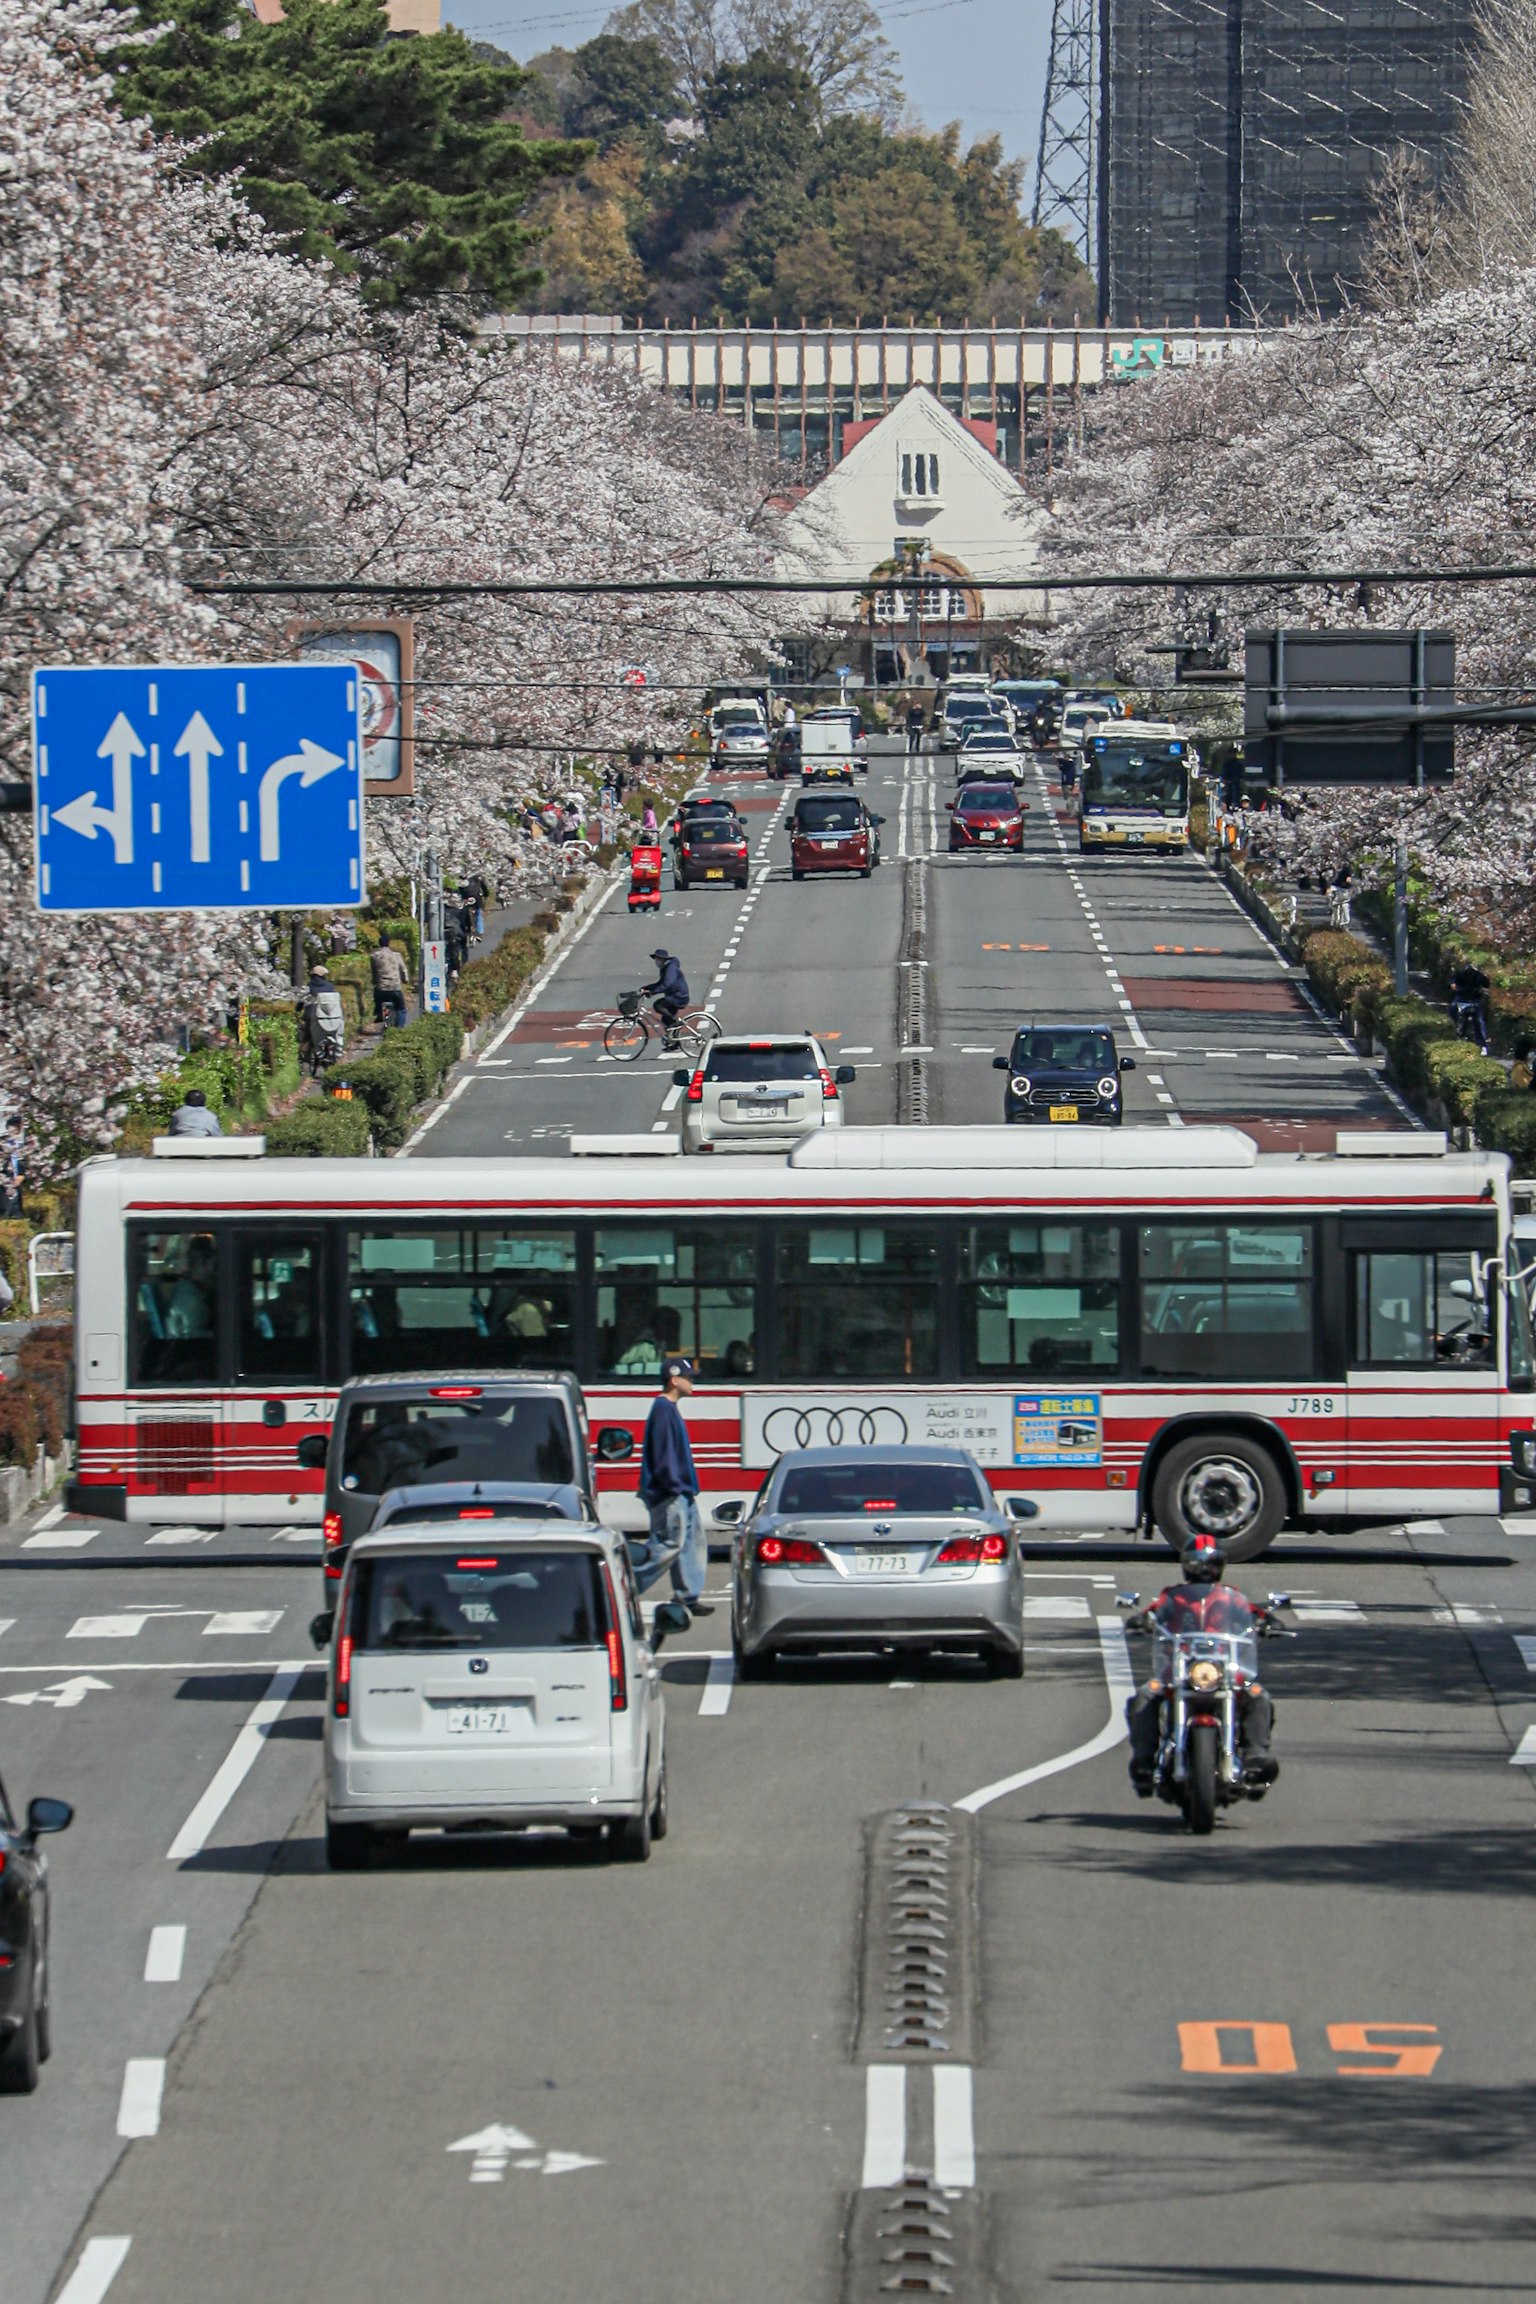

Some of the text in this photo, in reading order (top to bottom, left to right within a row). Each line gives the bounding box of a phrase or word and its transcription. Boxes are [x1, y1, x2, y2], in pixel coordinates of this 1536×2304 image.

[1112, 338, 1164, 367] JR
[1287, 1398, 1334, 1413] J789
[926, 1408, 987, 1418] Audi 立川
[926, 1428, 999, 1438] Audi 西東京
[868, 1556, 906, 1570] 77-73
[462, 1713, 506, 1729] 41-71
